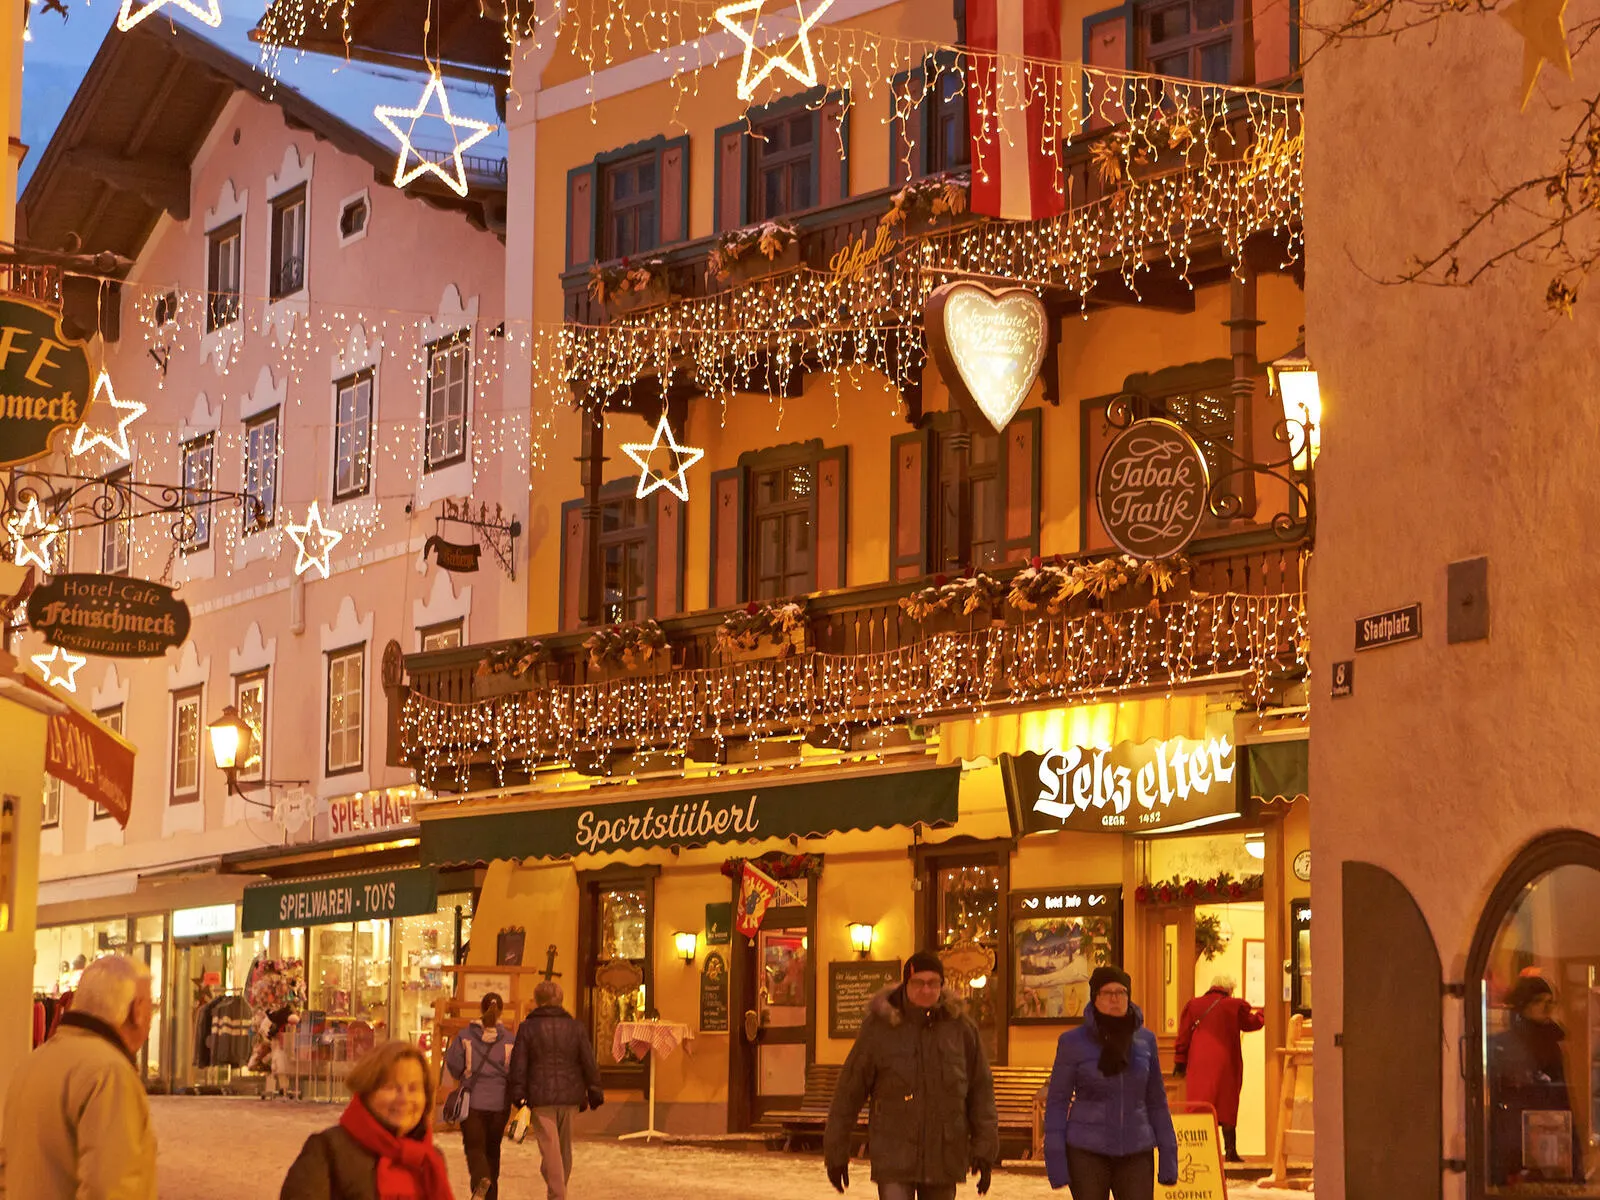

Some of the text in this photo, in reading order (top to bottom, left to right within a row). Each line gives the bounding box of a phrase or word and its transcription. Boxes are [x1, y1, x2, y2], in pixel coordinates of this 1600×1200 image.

[1110, 450, 1195, 492] Tabak
[1110, 489, 1195, 528] Trafik
[36, 601, 177, 636] Feinschmeck
[1363, 613, 1410, 642] Stadtplatz
[52, 628, 162, 653] Restaurant-Bar
[1336, 664, 1345, 685] 8
[1033, 734, 1236, 824] Lebzelter
[576, 795, 760, 853] Sportstüberl
[280, 887, 353, 921] SPIELWAREN
[364, 882, 396, 913] TOYS
[1177, 1129, 1208, 1142] seum
